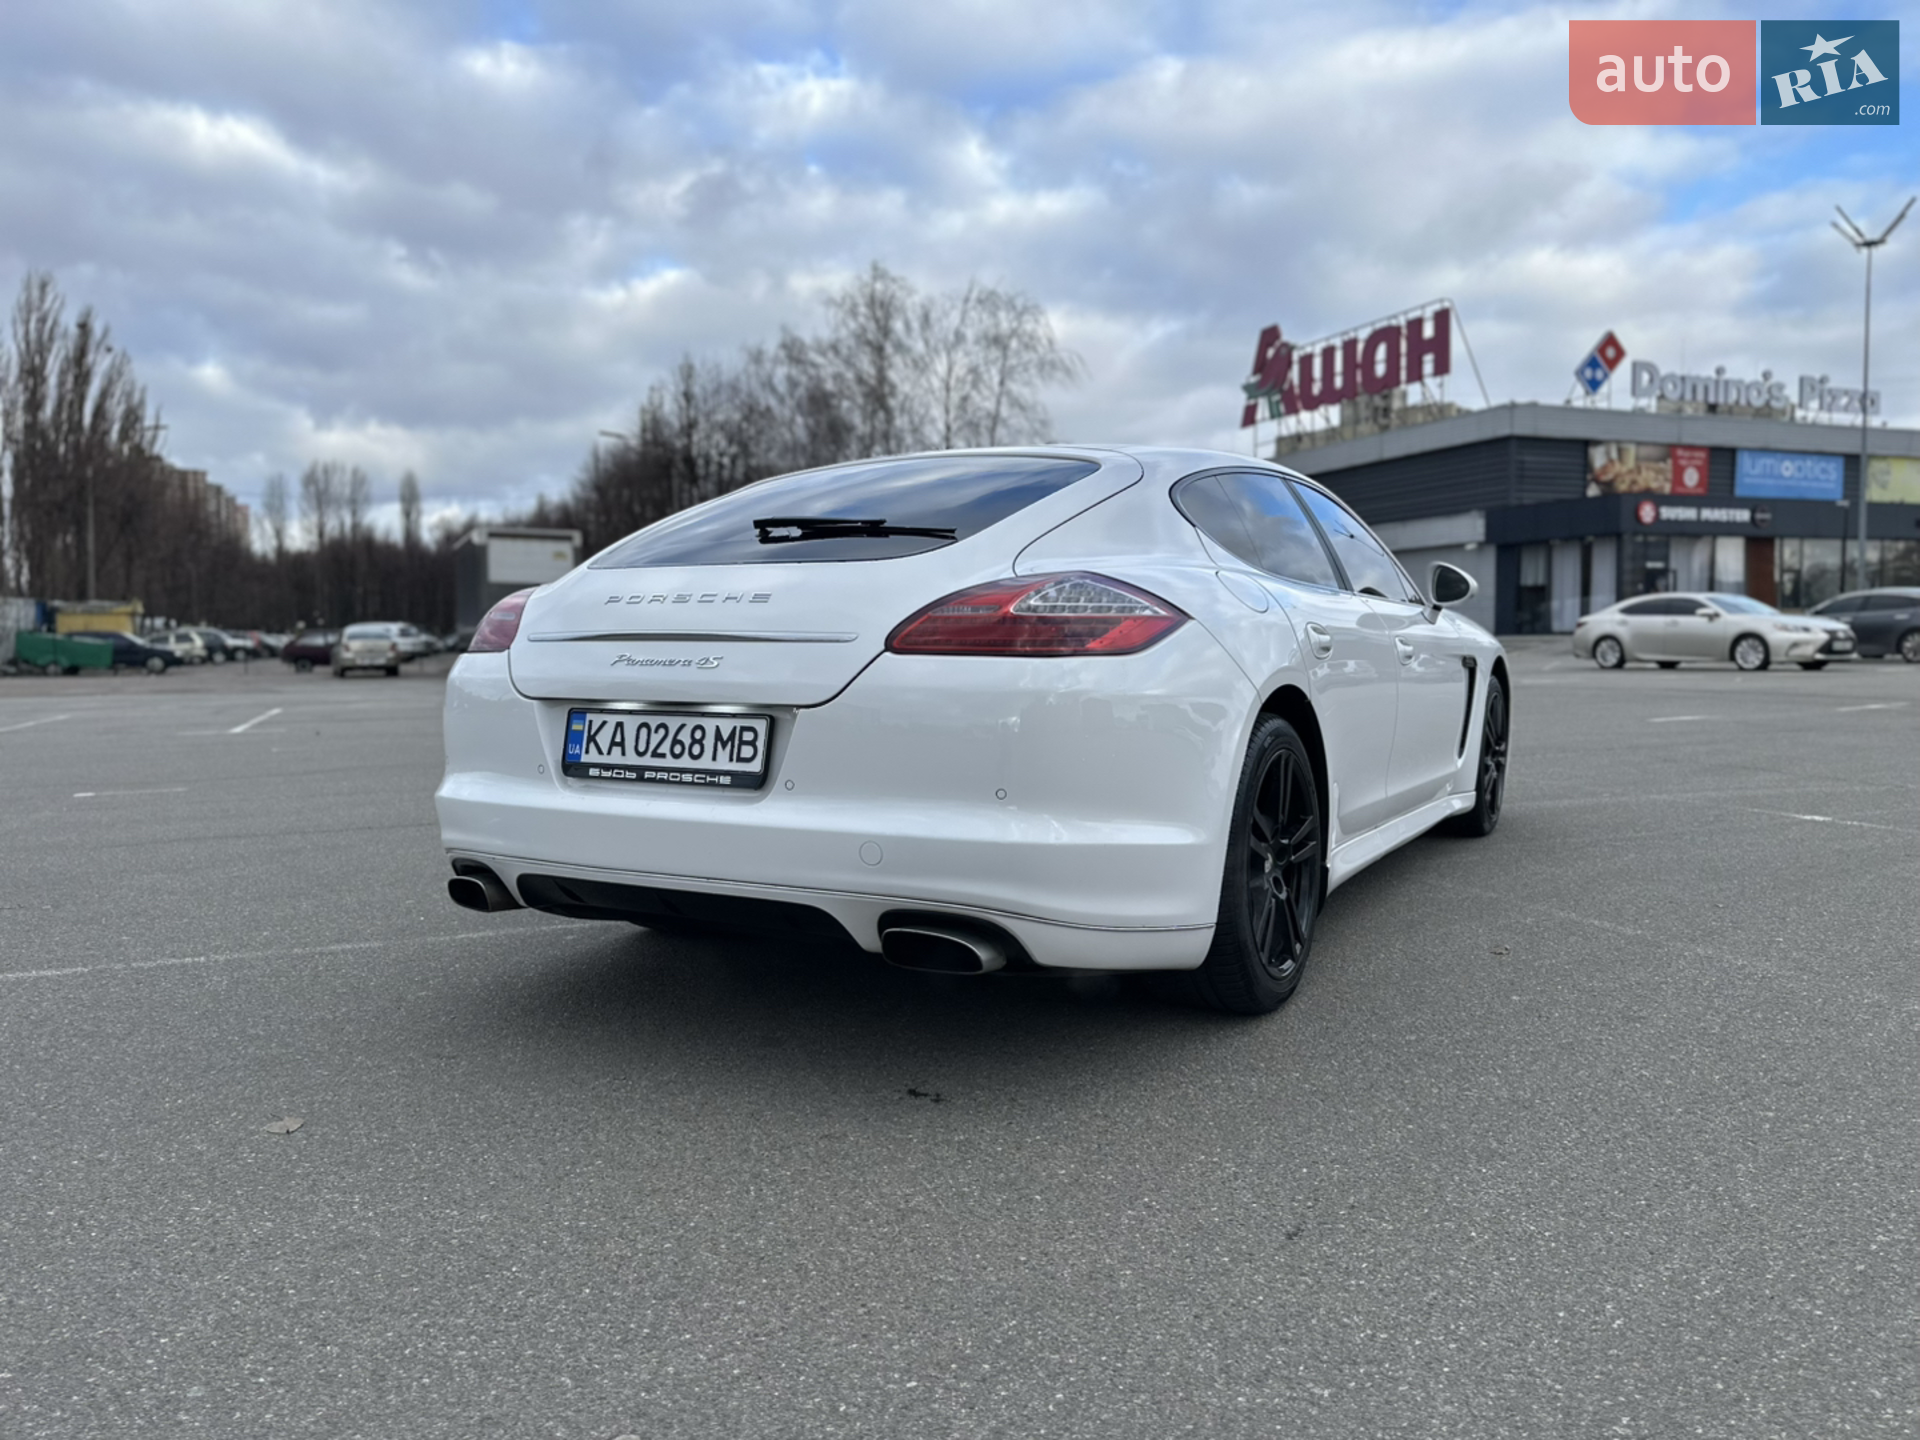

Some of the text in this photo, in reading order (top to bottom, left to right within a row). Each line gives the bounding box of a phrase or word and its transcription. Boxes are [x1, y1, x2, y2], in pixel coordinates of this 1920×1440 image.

[1631, 360, 1881, 415] Domino's Pizza
[1659, 505, 1698, 522] SUSHI
[1700, 507, 1751, 523] MASTER
[604, 591, 772, 605] PORSCHE
[610, 652, 723, 669] Panamera 4S
[568, 744, 581, 755] UA
[585, 719, 759, 764] KA 0268 MB
[644, 771, 732, 785] PROSCHE
